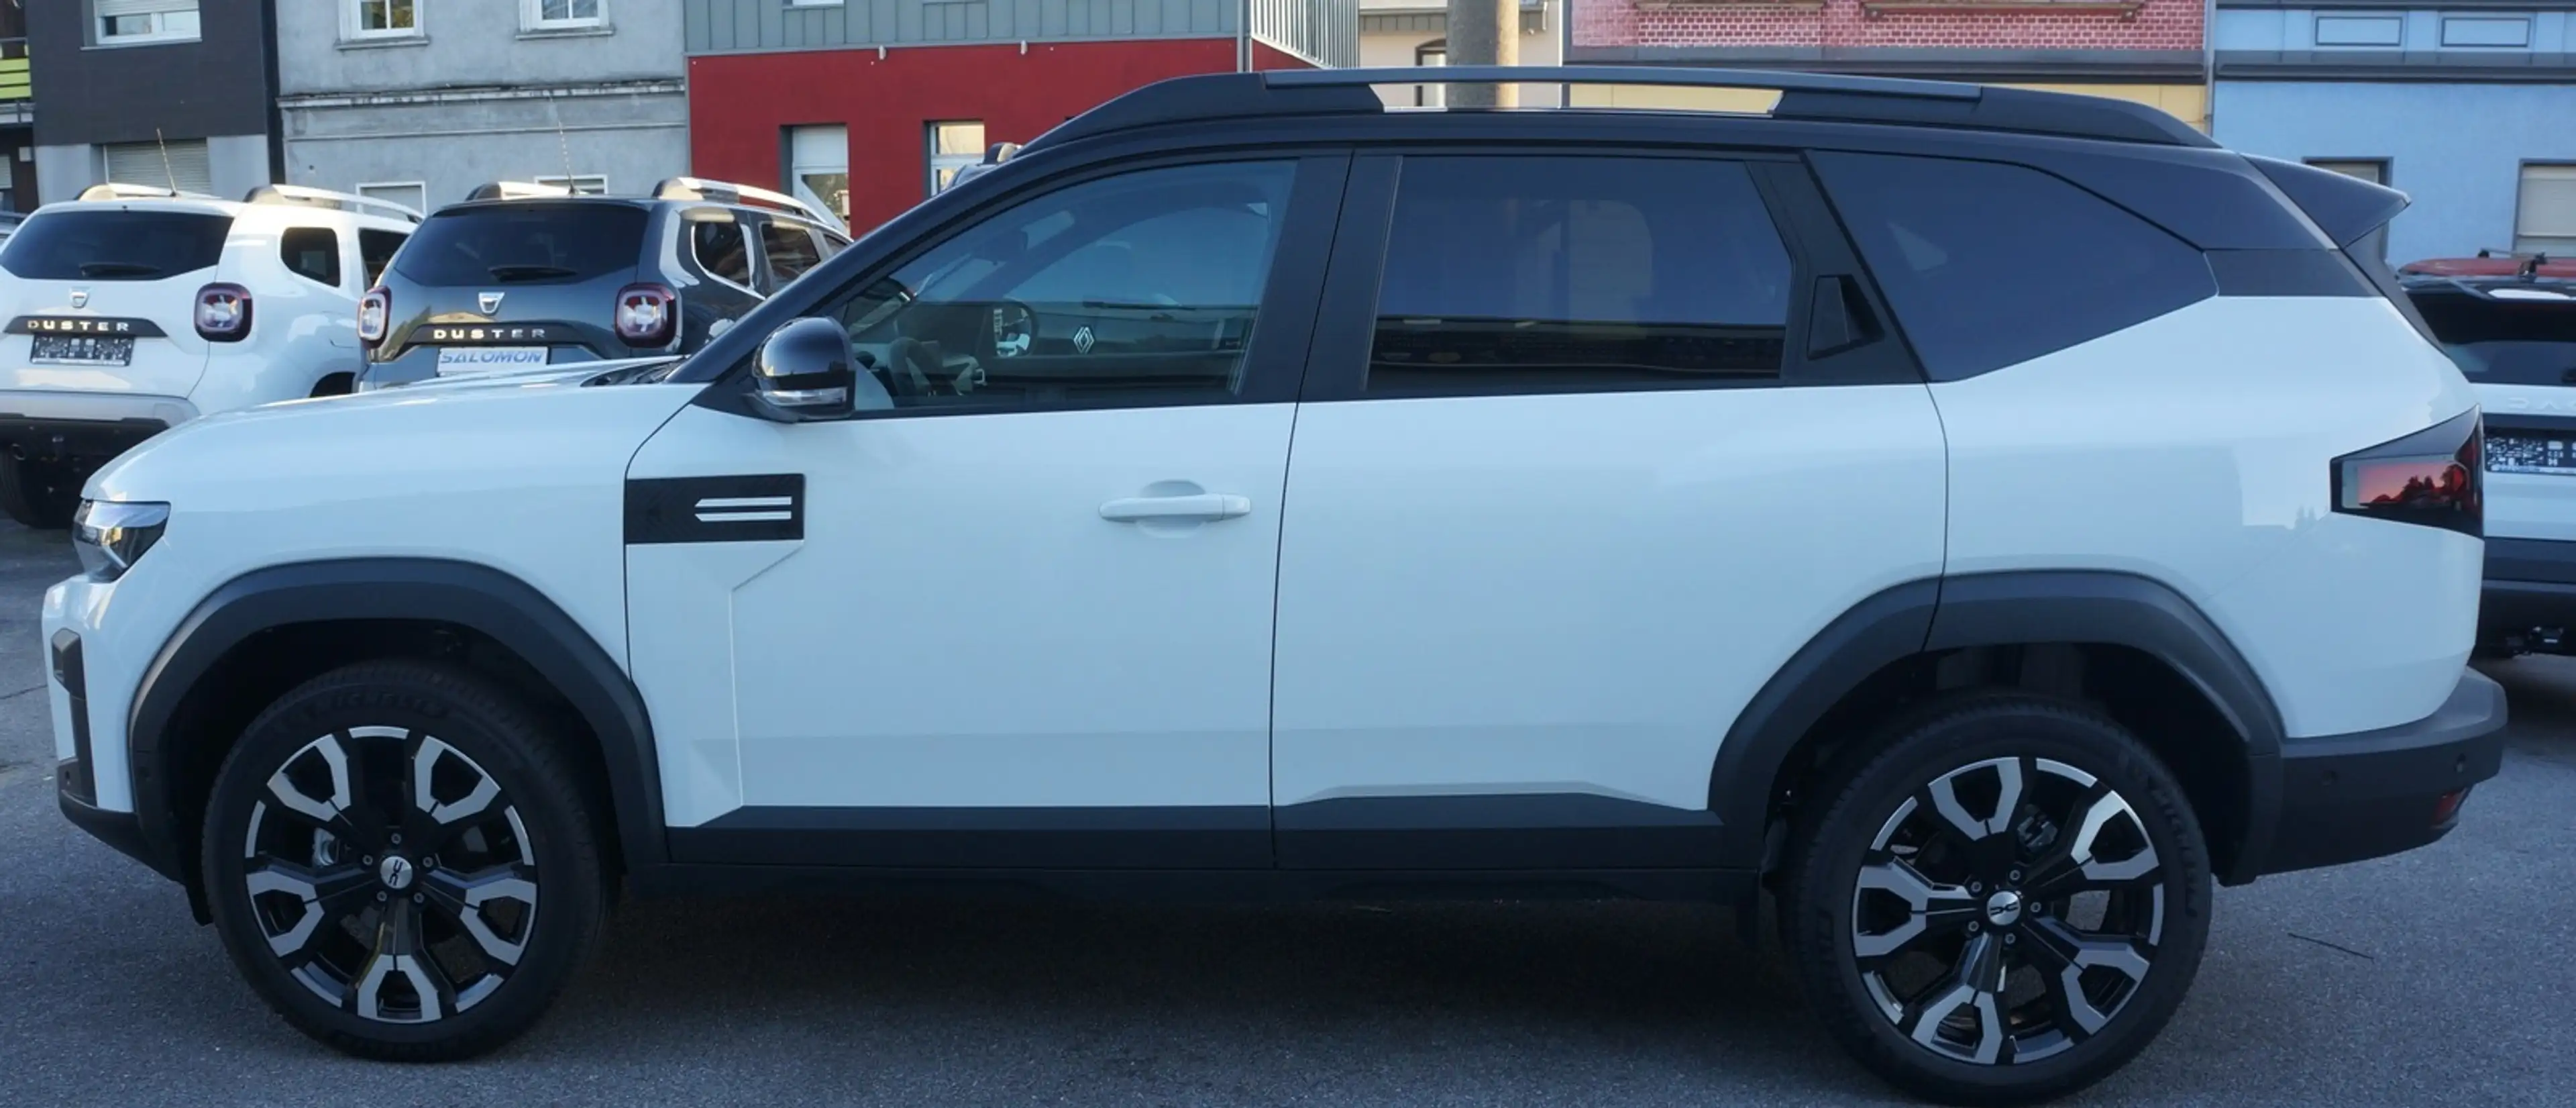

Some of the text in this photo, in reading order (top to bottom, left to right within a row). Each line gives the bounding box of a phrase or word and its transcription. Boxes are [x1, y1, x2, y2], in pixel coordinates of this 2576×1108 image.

[28, 319, 129, 332] DUSTER
[433, 328, 545, 340] DUSTER
[440, 350, 542, 364] SALOMON
